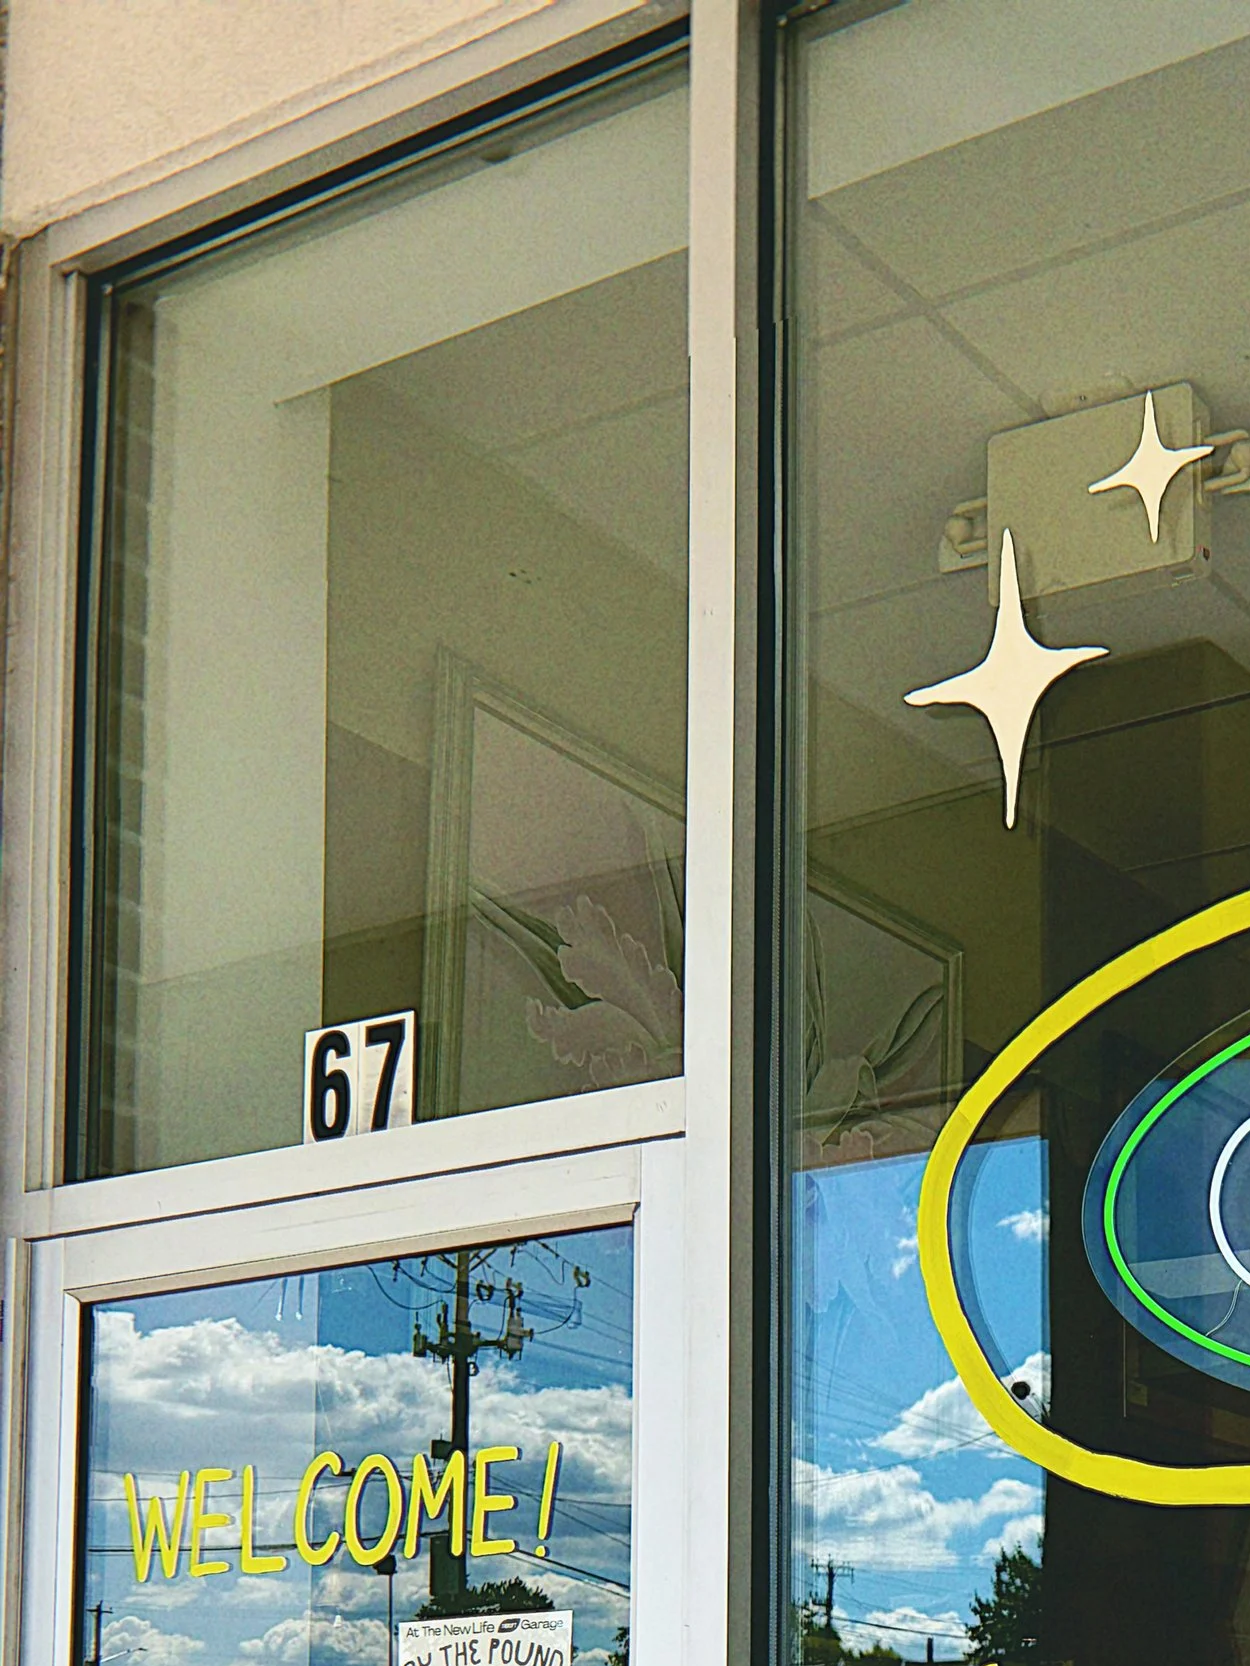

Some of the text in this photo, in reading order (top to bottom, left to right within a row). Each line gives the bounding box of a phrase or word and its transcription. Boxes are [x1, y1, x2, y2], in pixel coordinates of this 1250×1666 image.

[310, 1018, 406, 1142] 67
[125, 1441, 560, 1583] WELCOME!
[406, 1627, 419, 1638] At
[422, 1625, 441, 1637] The
[443, 1624, 471, 1636] New
[472, 1621, 495, 1633] Life
[521, 1619, 564, 1631] Garage
